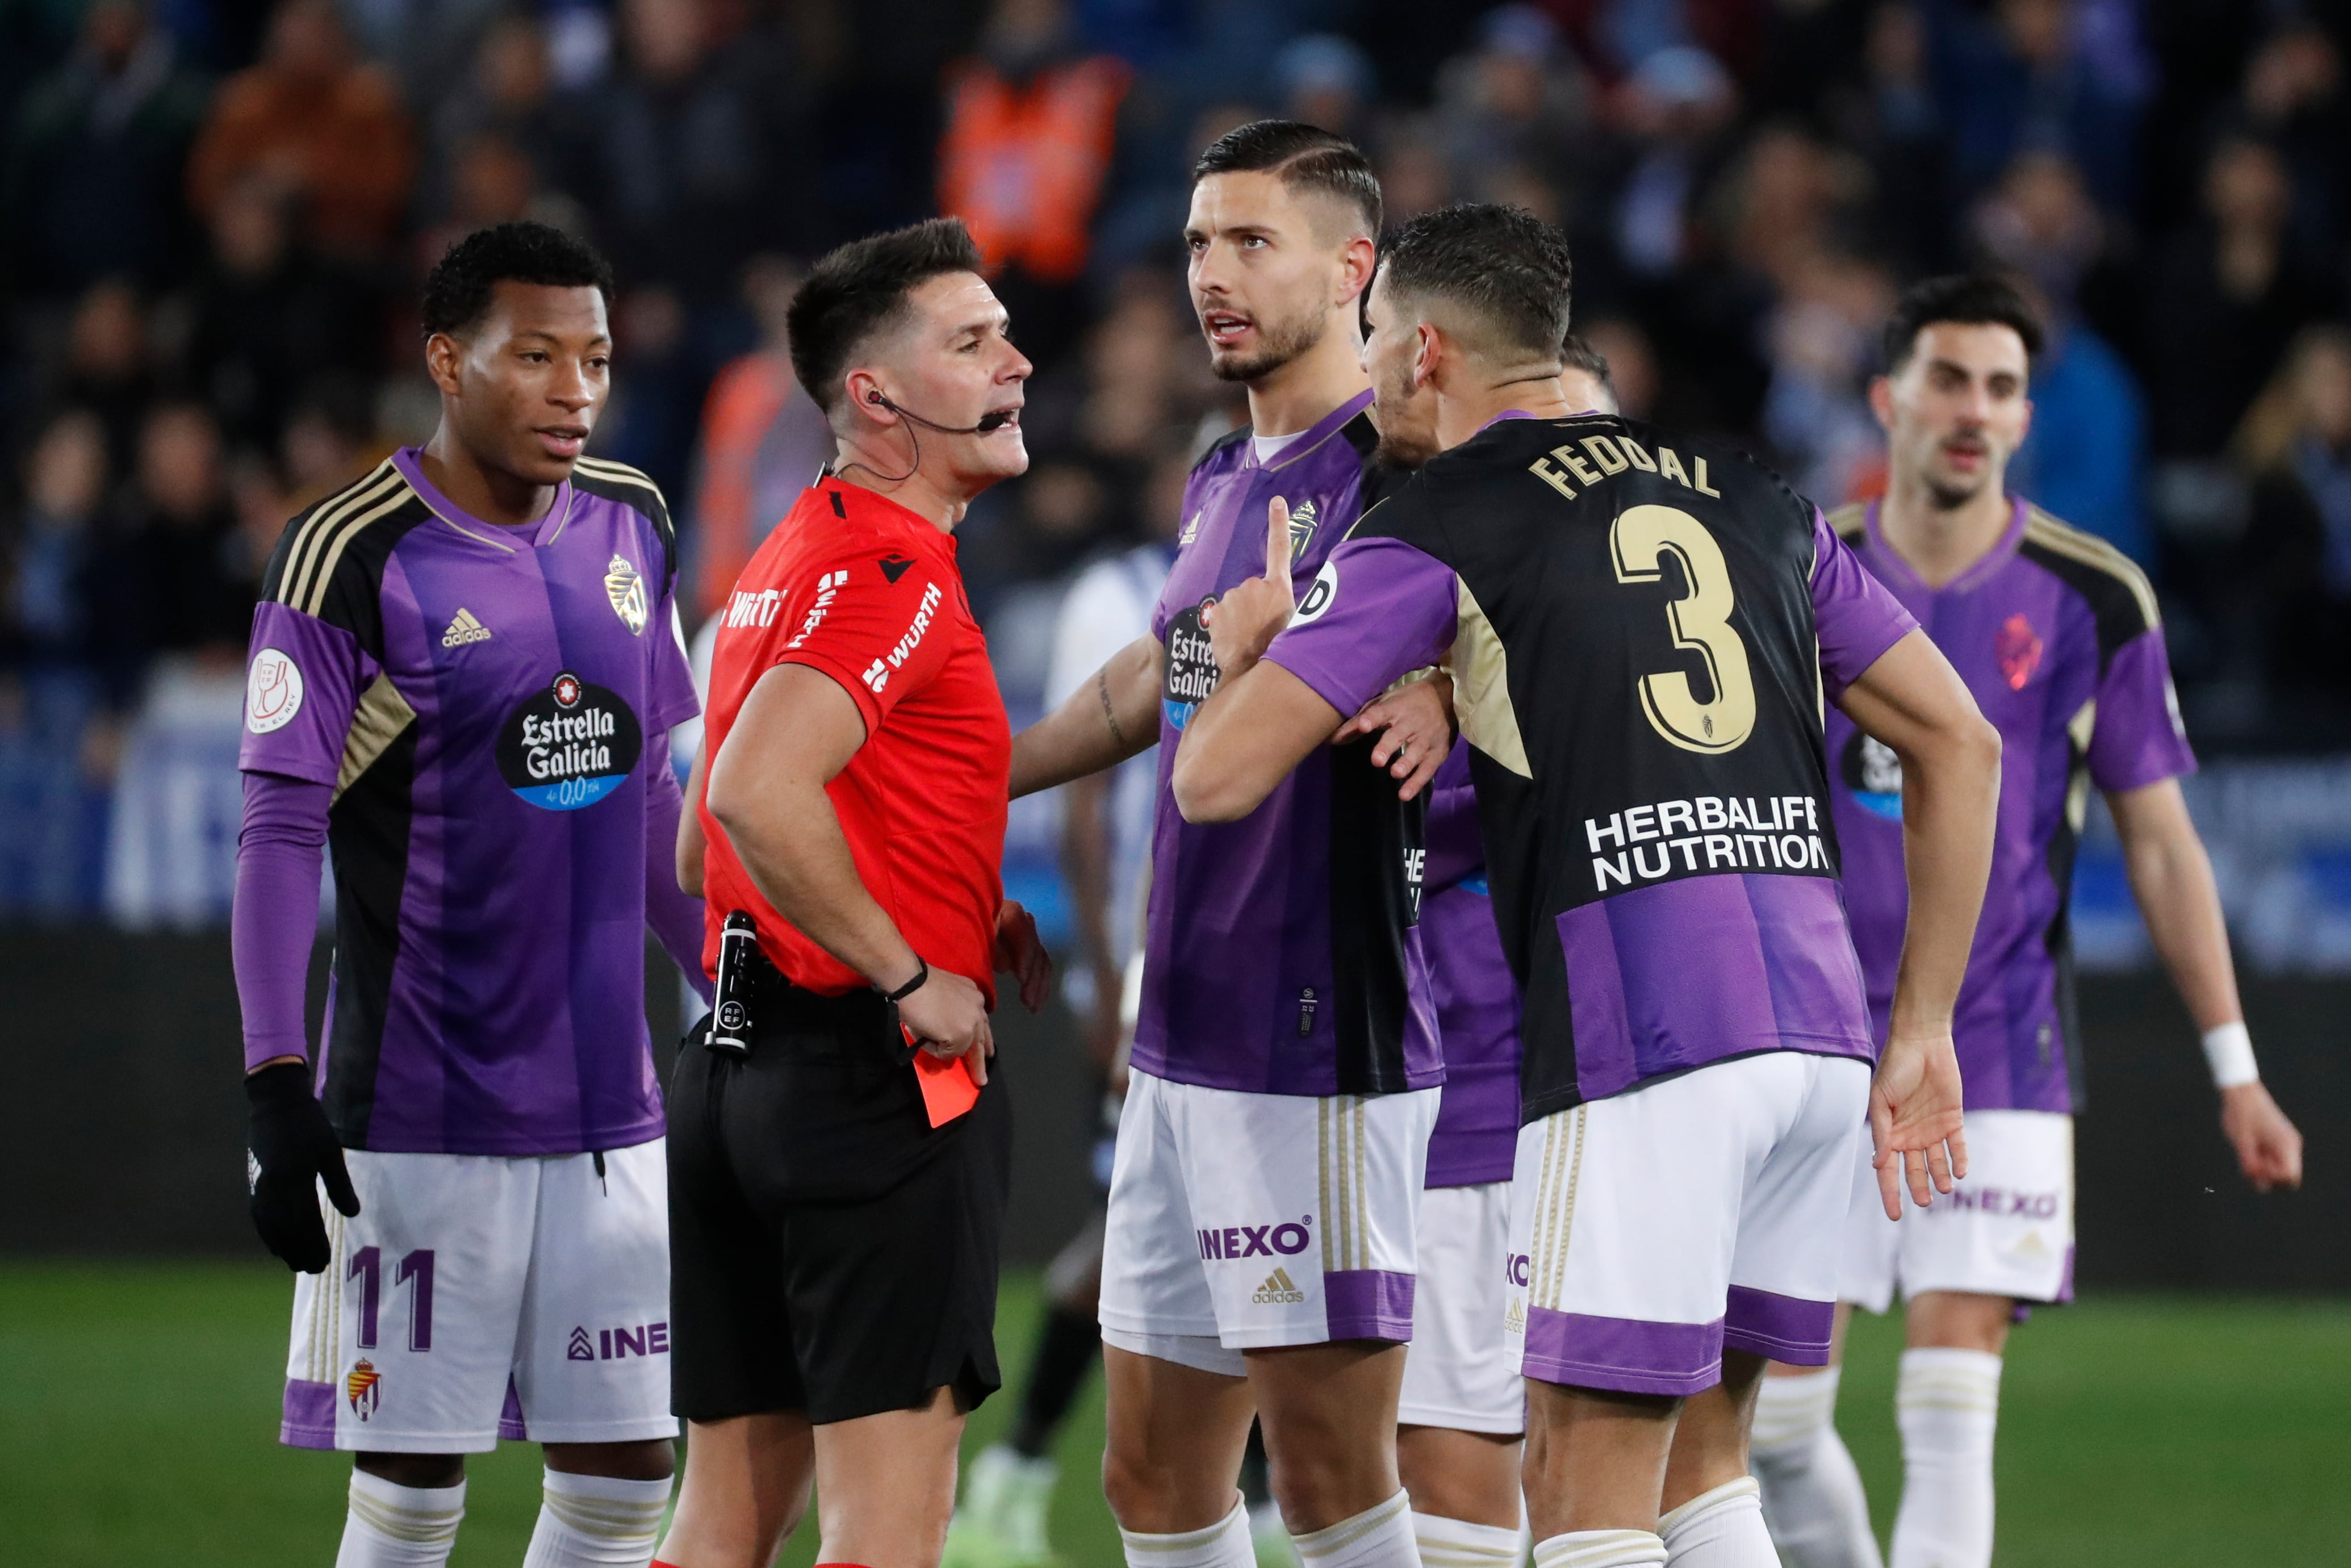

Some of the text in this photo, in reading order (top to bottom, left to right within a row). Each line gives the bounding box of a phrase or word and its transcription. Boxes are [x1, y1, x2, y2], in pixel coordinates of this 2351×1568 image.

[1528, 435, 1720, 500] FEDDAL
[442, 628, 491, 647] adidas
[886, 582, 942, 668] WÜRTH
[1609, 504, 1757, 754] 3
[521, 707, 615, 747] Estrella
[526, 739, 611, 779] Galicia
[346, 1246, 434, 1352] 11
[1252, 1290, 1304, 1304] adidas
